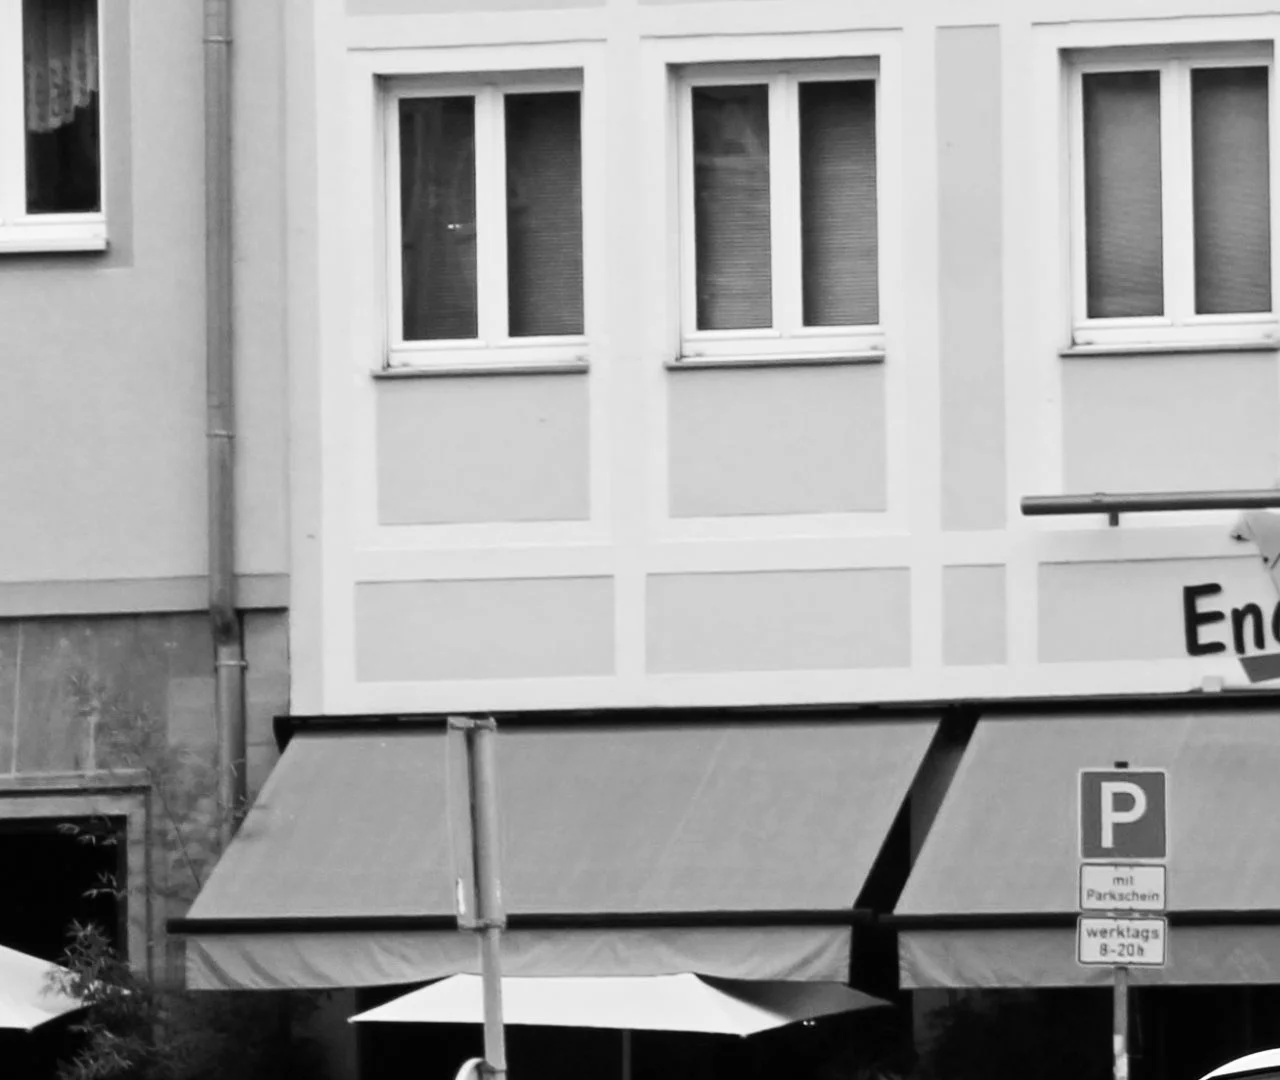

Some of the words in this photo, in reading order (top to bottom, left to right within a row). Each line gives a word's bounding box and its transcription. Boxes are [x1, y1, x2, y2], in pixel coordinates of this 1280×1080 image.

[1101, 781, 1147, 848] P
[1112, 874, 1135, 886] mit
[1086, 888, 1160, 902] Parkschein
[1086, 924, 1160, 943] werktags
